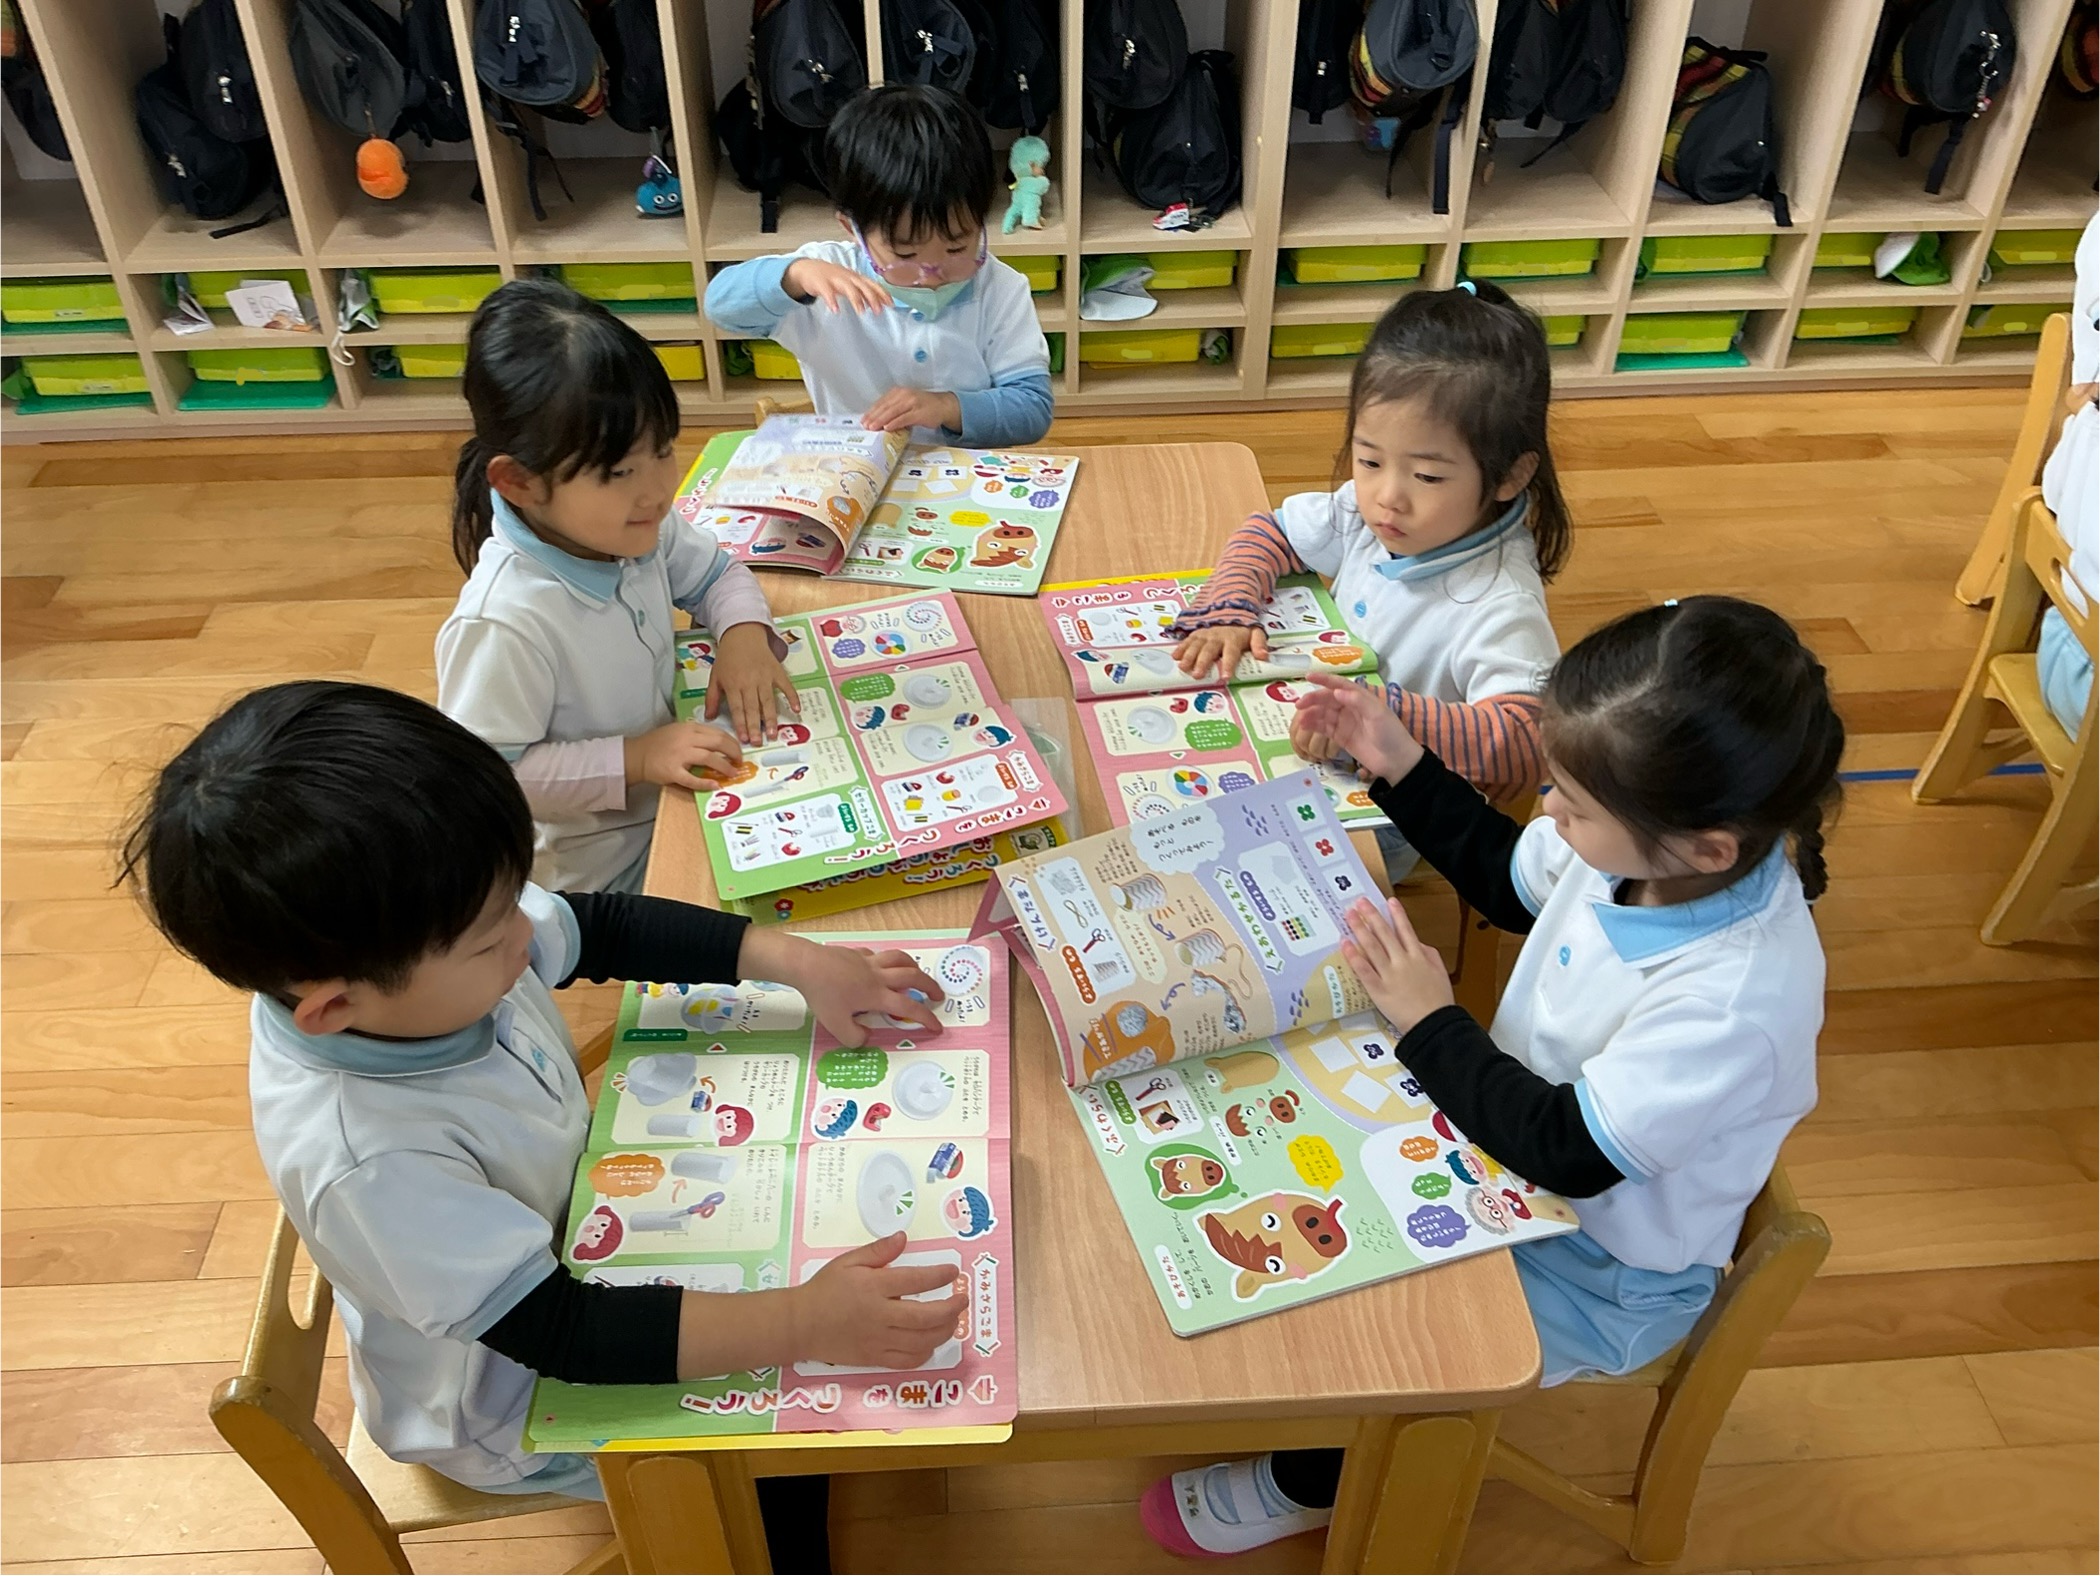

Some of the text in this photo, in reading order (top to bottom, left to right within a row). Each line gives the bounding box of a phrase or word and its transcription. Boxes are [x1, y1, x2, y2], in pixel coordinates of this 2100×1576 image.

[1146, 814, 1201, 837] あそべる ものを
[1152, 837, 1175, 850] もっと
[904, 854, 999, 883] つくろう！
[1158, 837, 1214, 862] つくってみよう！
[1016, 888, 1045, 938] けんだま
[1242, 873, 1272, 918] よういする もの
[1222, 877, 1275, 958] えあわせかるた
[1064, 948, 1091, 1000] よういする もの
[1086, 1092, 1119, 1145] ふくわらい
[1214, 1122, 1236, 1158] かおの パーツ
[1170, 1211, 1213, 1295] かおの パーツを おいていく。
[1161, 1255, 1185, 1299] あそびかた
[1183, 1268, 1201, 1299] めかくしを
[681, 1380, 964, 1415] こまを つくろう！
